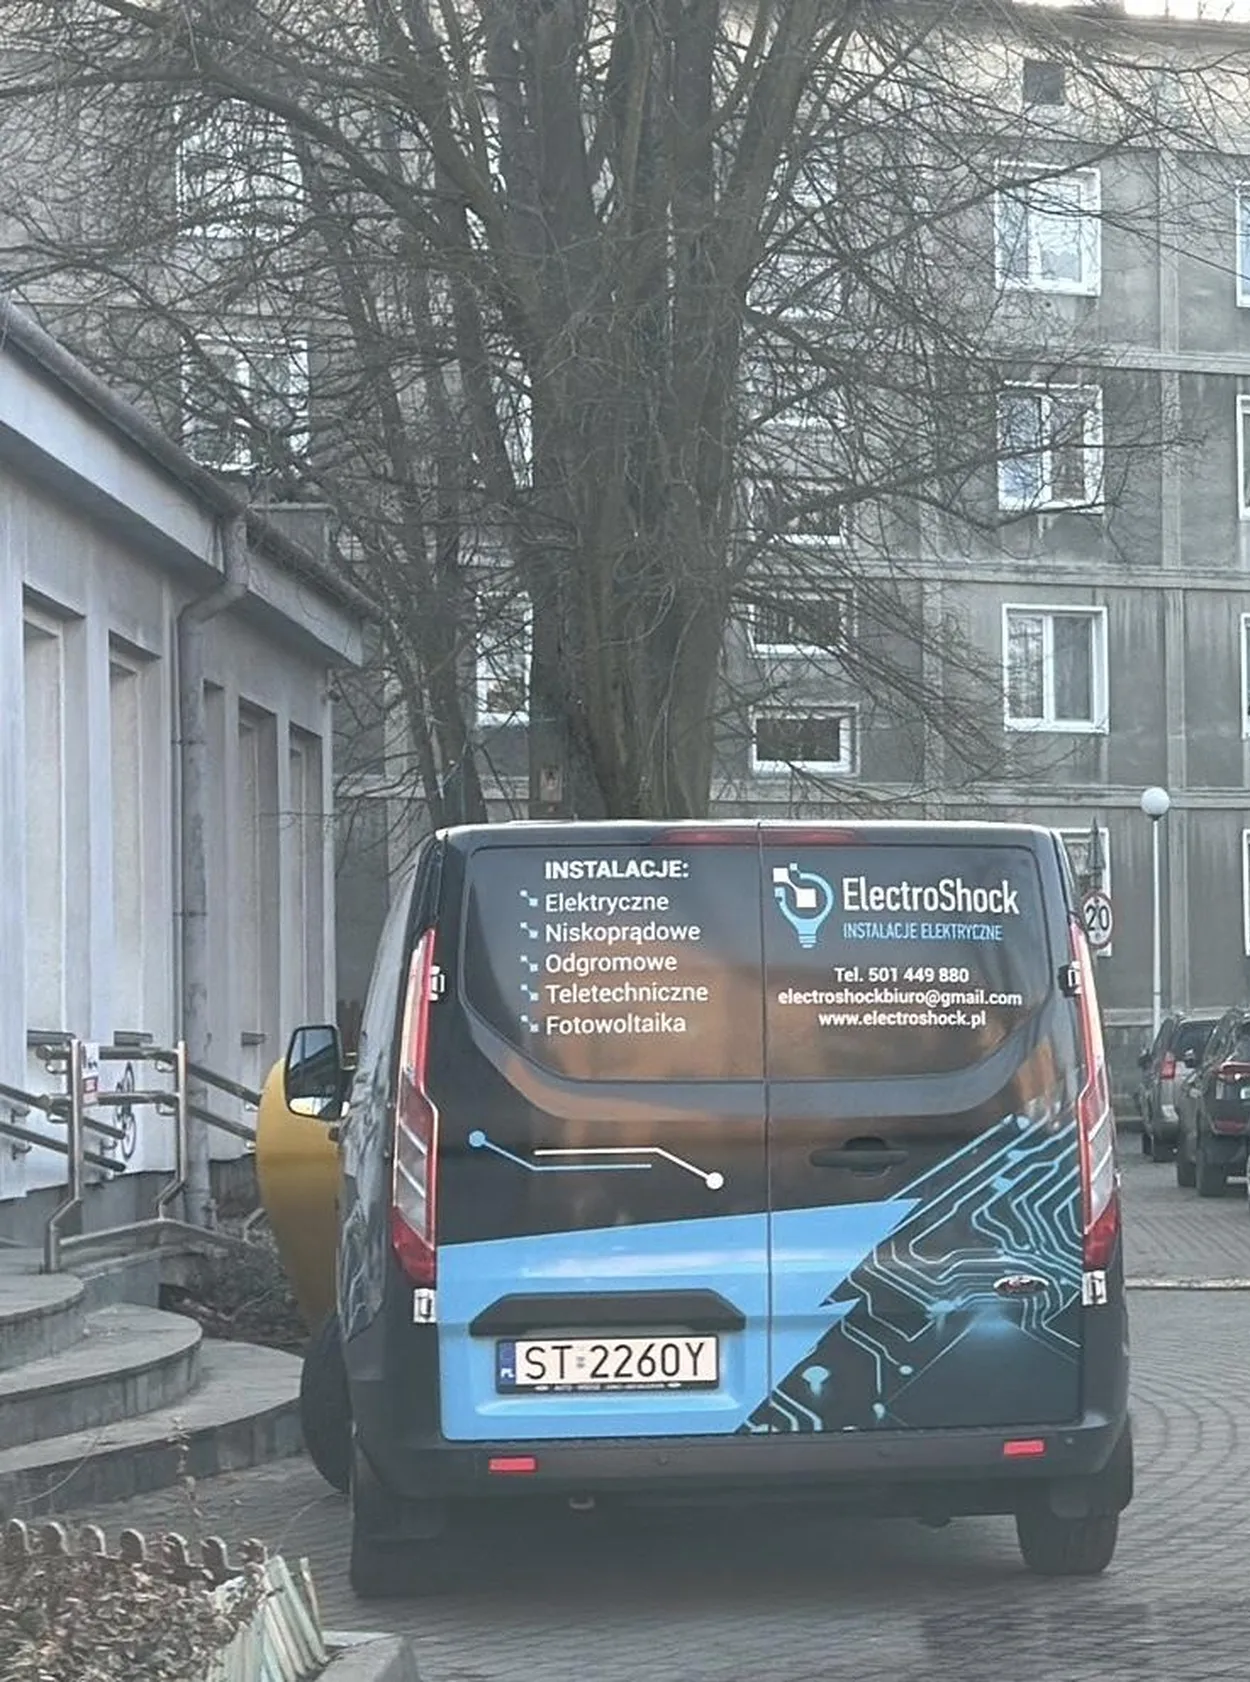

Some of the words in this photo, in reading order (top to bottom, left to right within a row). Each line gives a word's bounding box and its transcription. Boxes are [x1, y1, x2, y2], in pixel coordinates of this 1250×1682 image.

[544, 859, 690, 880] INSTALACJE:
[545, 892, 670, 915] Elektryczne
[842, 876, 1020, 915] ElectroShock
[1085, 904, 1110, 931] 20
[545, 921, 701, 945] Niskoprądowe
[843, 922, 918, 939] INSTALACJE
[920, 923, 1004, 941] ELEKTRYCZNE
[545, 952, 678, 977] Odgromowe
[834, 967, 864, 983] Tel.
[868, 967, 898, 983] 501
[903, 967, 935, 983] 449
[938, 967, 969, 983] 880
[544, 982, 709, 1004] Teletechniczne
[777, 988, 1023, 1008] electroshockbiuro@gmail.com
[546, 1012, 687, 1035] Fotowoltaika
[818, 1009, 986, 1029] www.electroshock.pl
